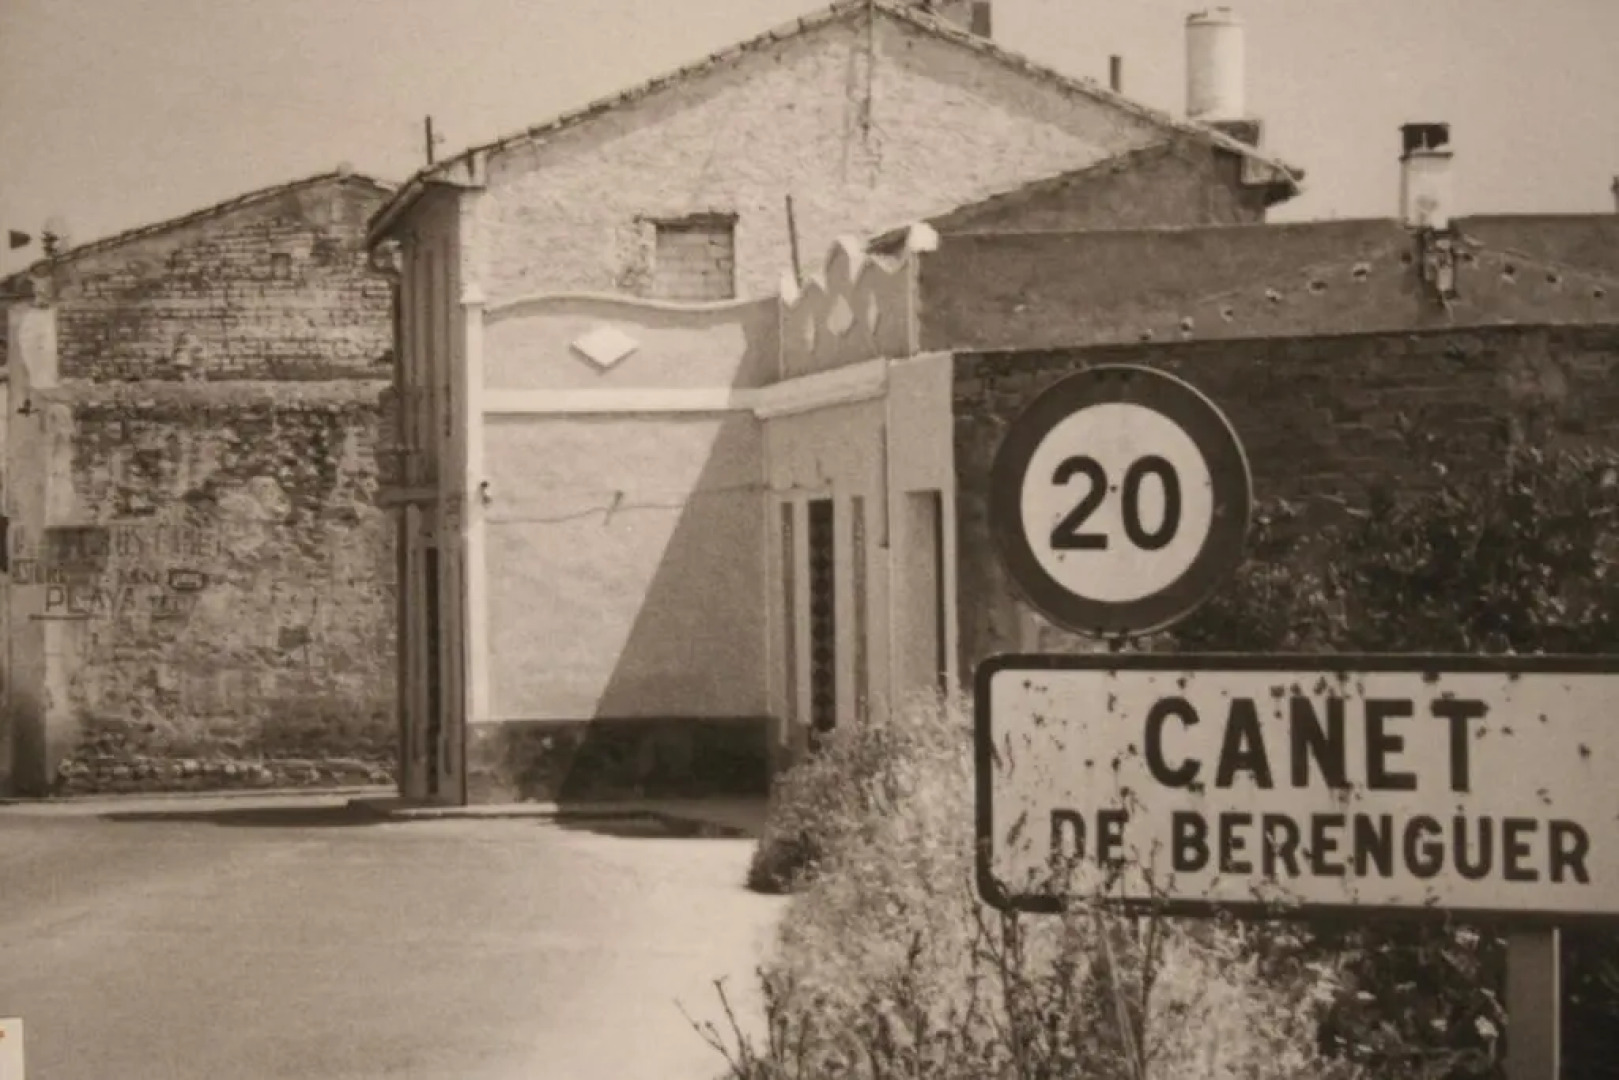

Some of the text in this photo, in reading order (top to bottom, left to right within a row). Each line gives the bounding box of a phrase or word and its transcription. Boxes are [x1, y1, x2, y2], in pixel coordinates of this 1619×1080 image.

[1050, 455, 1181, 550] 20
[1144, 697, 1488, 792] CANET
[1051, 809, 1590, 884] DE BERENGUER
